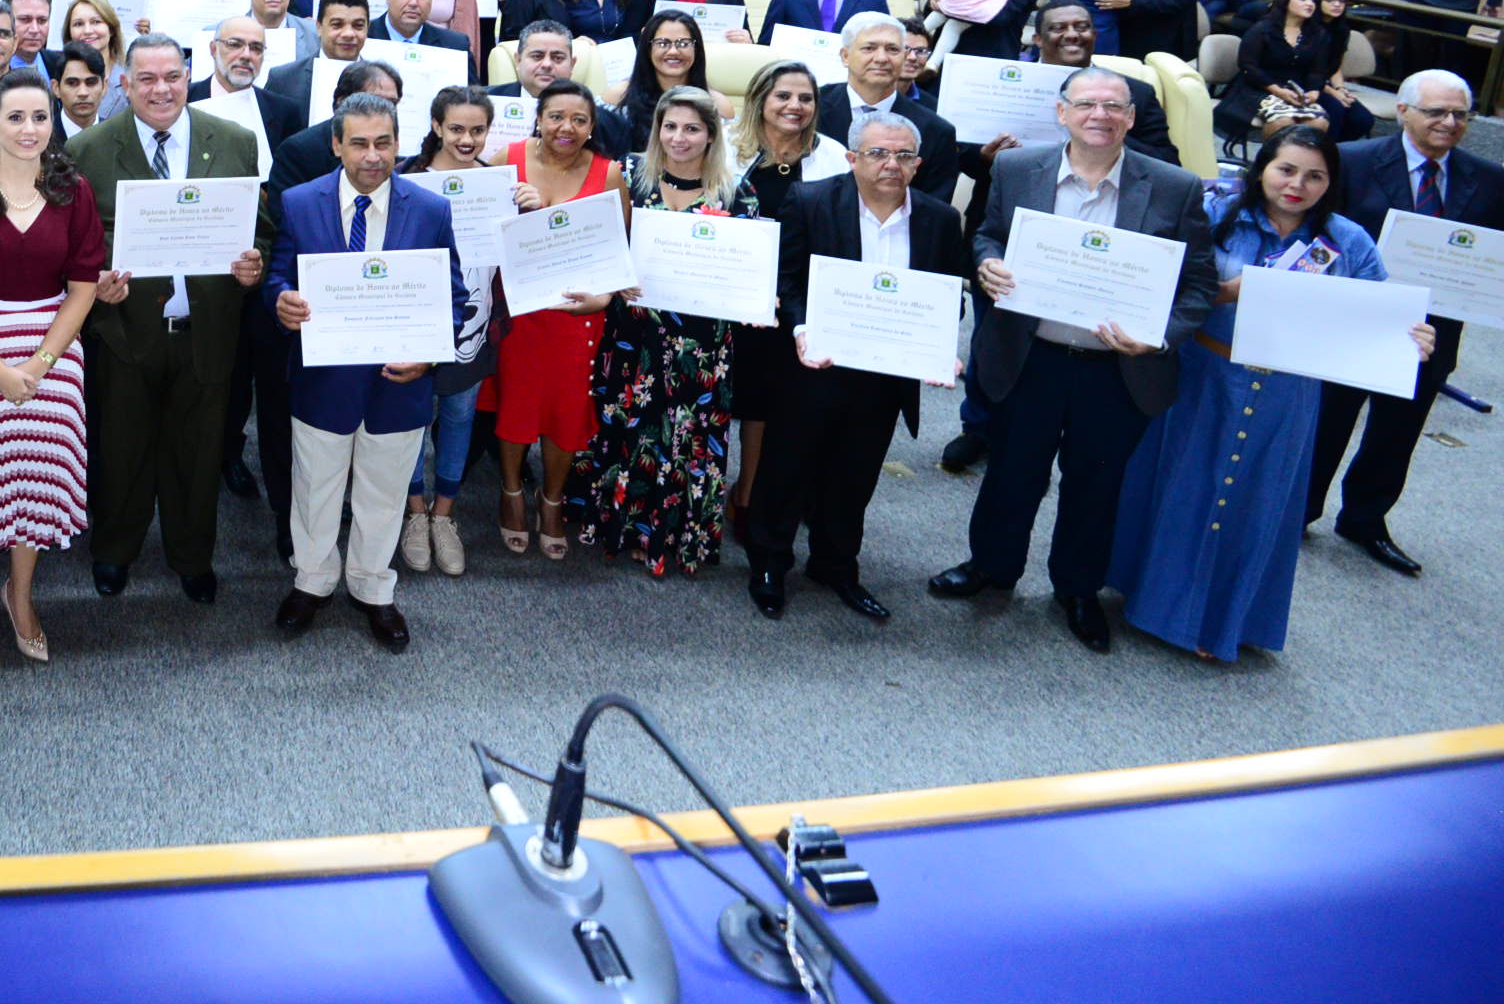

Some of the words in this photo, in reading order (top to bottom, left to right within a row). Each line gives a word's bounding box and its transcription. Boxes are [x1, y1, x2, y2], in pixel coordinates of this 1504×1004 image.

[139, 207, 169, 217] Diploma
[178, 206, 200, 214] Honra
[210, 204, 236, 213] Mérito
[1036, 241, 1068, 256] Diploma
[1082, 251, 1108, 265] Honra
[1121, 261, 1150, 275] Mérito
[324, 283, 354, 293] Diploma
[366, 283, 390, 292] Honra
[401, 280, 427, 290] Mérito
[909, 300, 935, 311] Mérito
